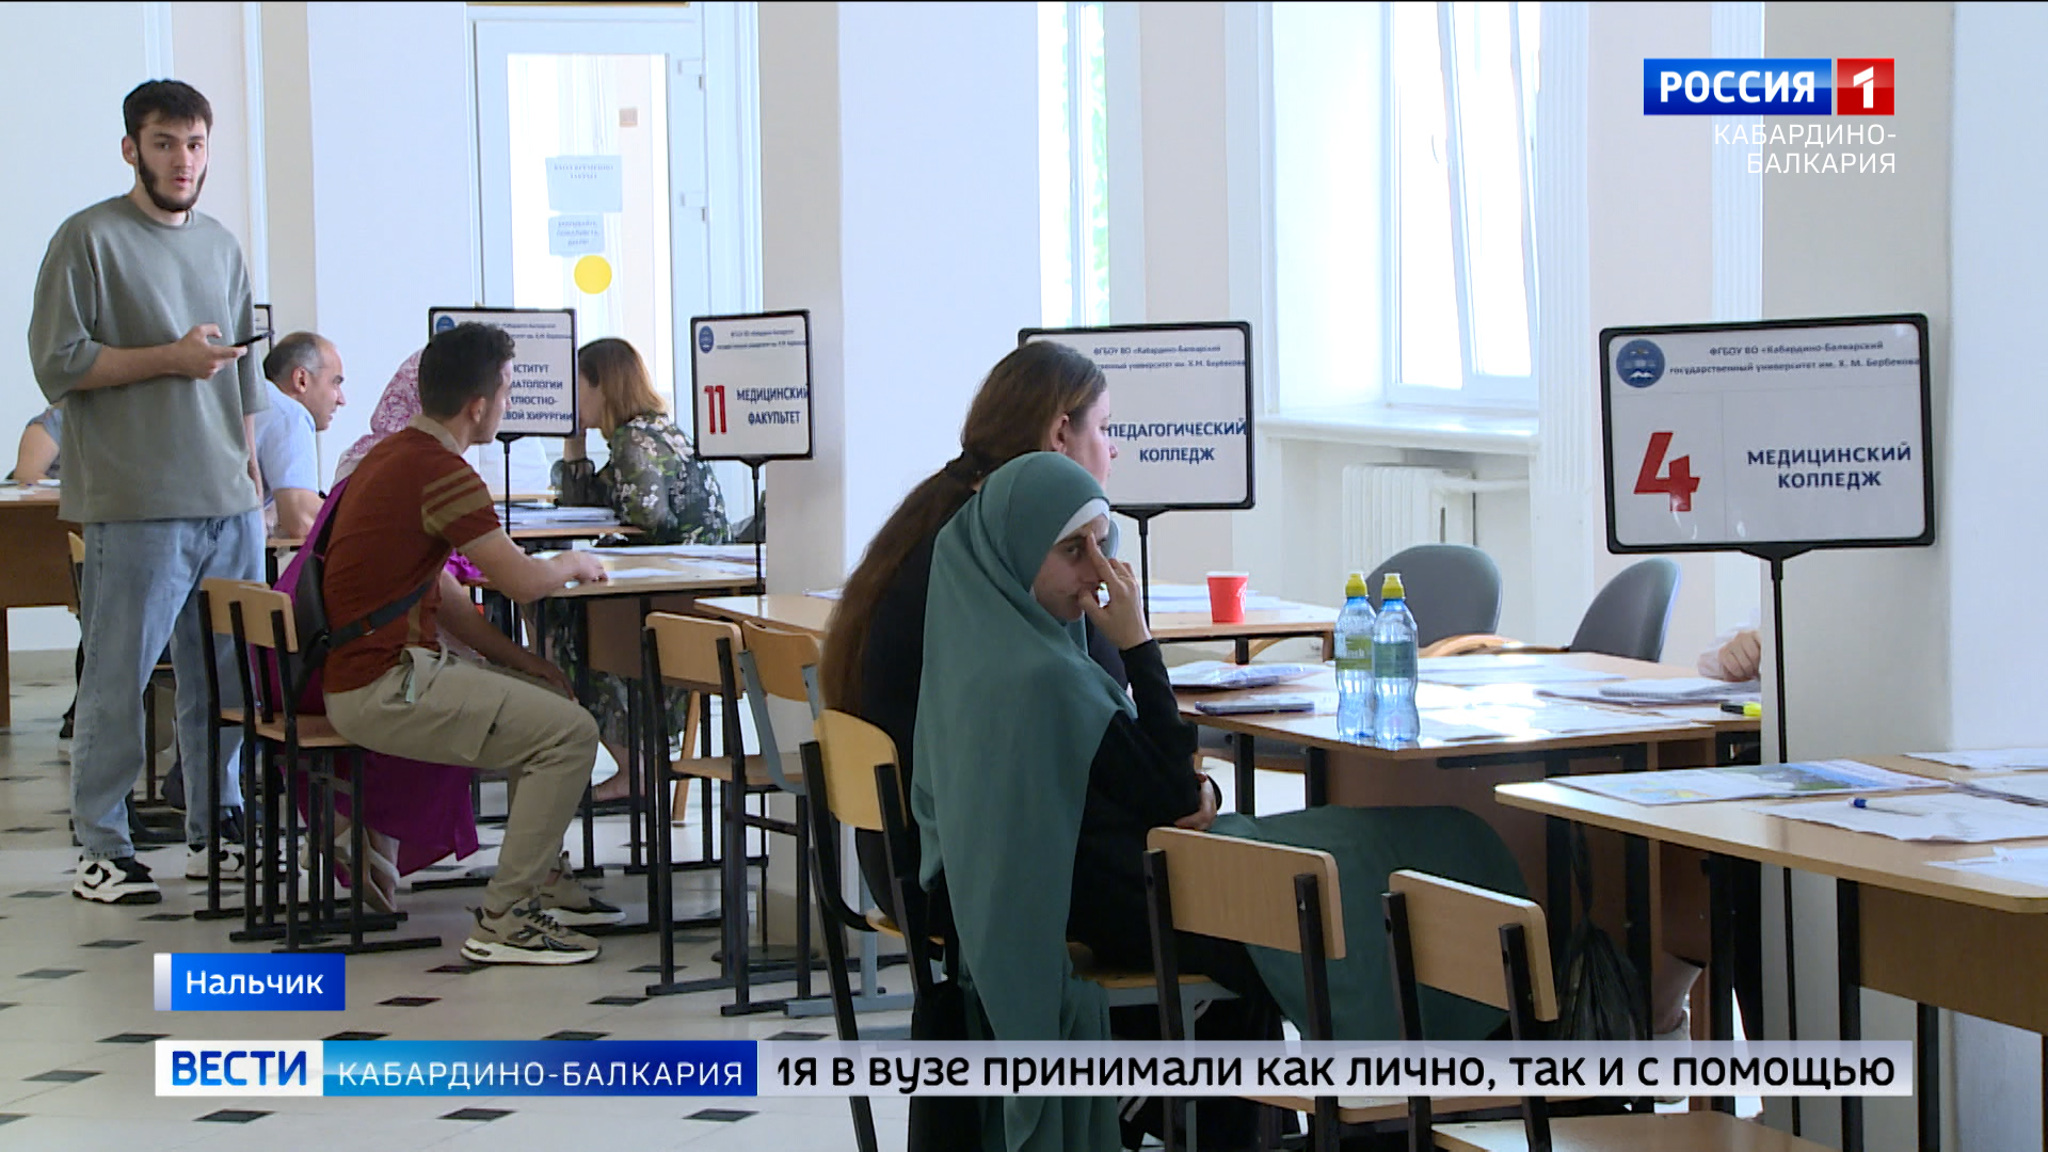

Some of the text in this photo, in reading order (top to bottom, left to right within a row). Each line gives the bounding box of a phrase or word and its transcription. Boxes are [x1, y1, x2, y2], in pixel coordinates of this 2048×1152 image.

[1709, 346, 1743, 357] ФГБОУ
[1744, 345, 1758, 355] ВО
[513, 364, 549, 374] СТИТУТ
[1668, 363, 1754, 376] государственный
[1756, 361, 1816, 373] университет
[737, 383, 809, 405] МЕДИЦИНСКИЙ
[526, 410, 574, 421] ХИРУРГИИ
[704, 385, 728, 434] 11
[748, 410, 801, 426] ФАКУЛЬТЕТ
[1108, 417, 1247, 441] ПЕДАГОГИЧЕСКИЙ
[1139, 446, 1215, 465] КОЛЛЕДЖ
[1747, 441, 1912, 470] МЕДИЦИНСКИЙ
[1633, 431, 1701, 513] 4
[1777, 470, 1882, 491] КОЛЛЕДЖ
